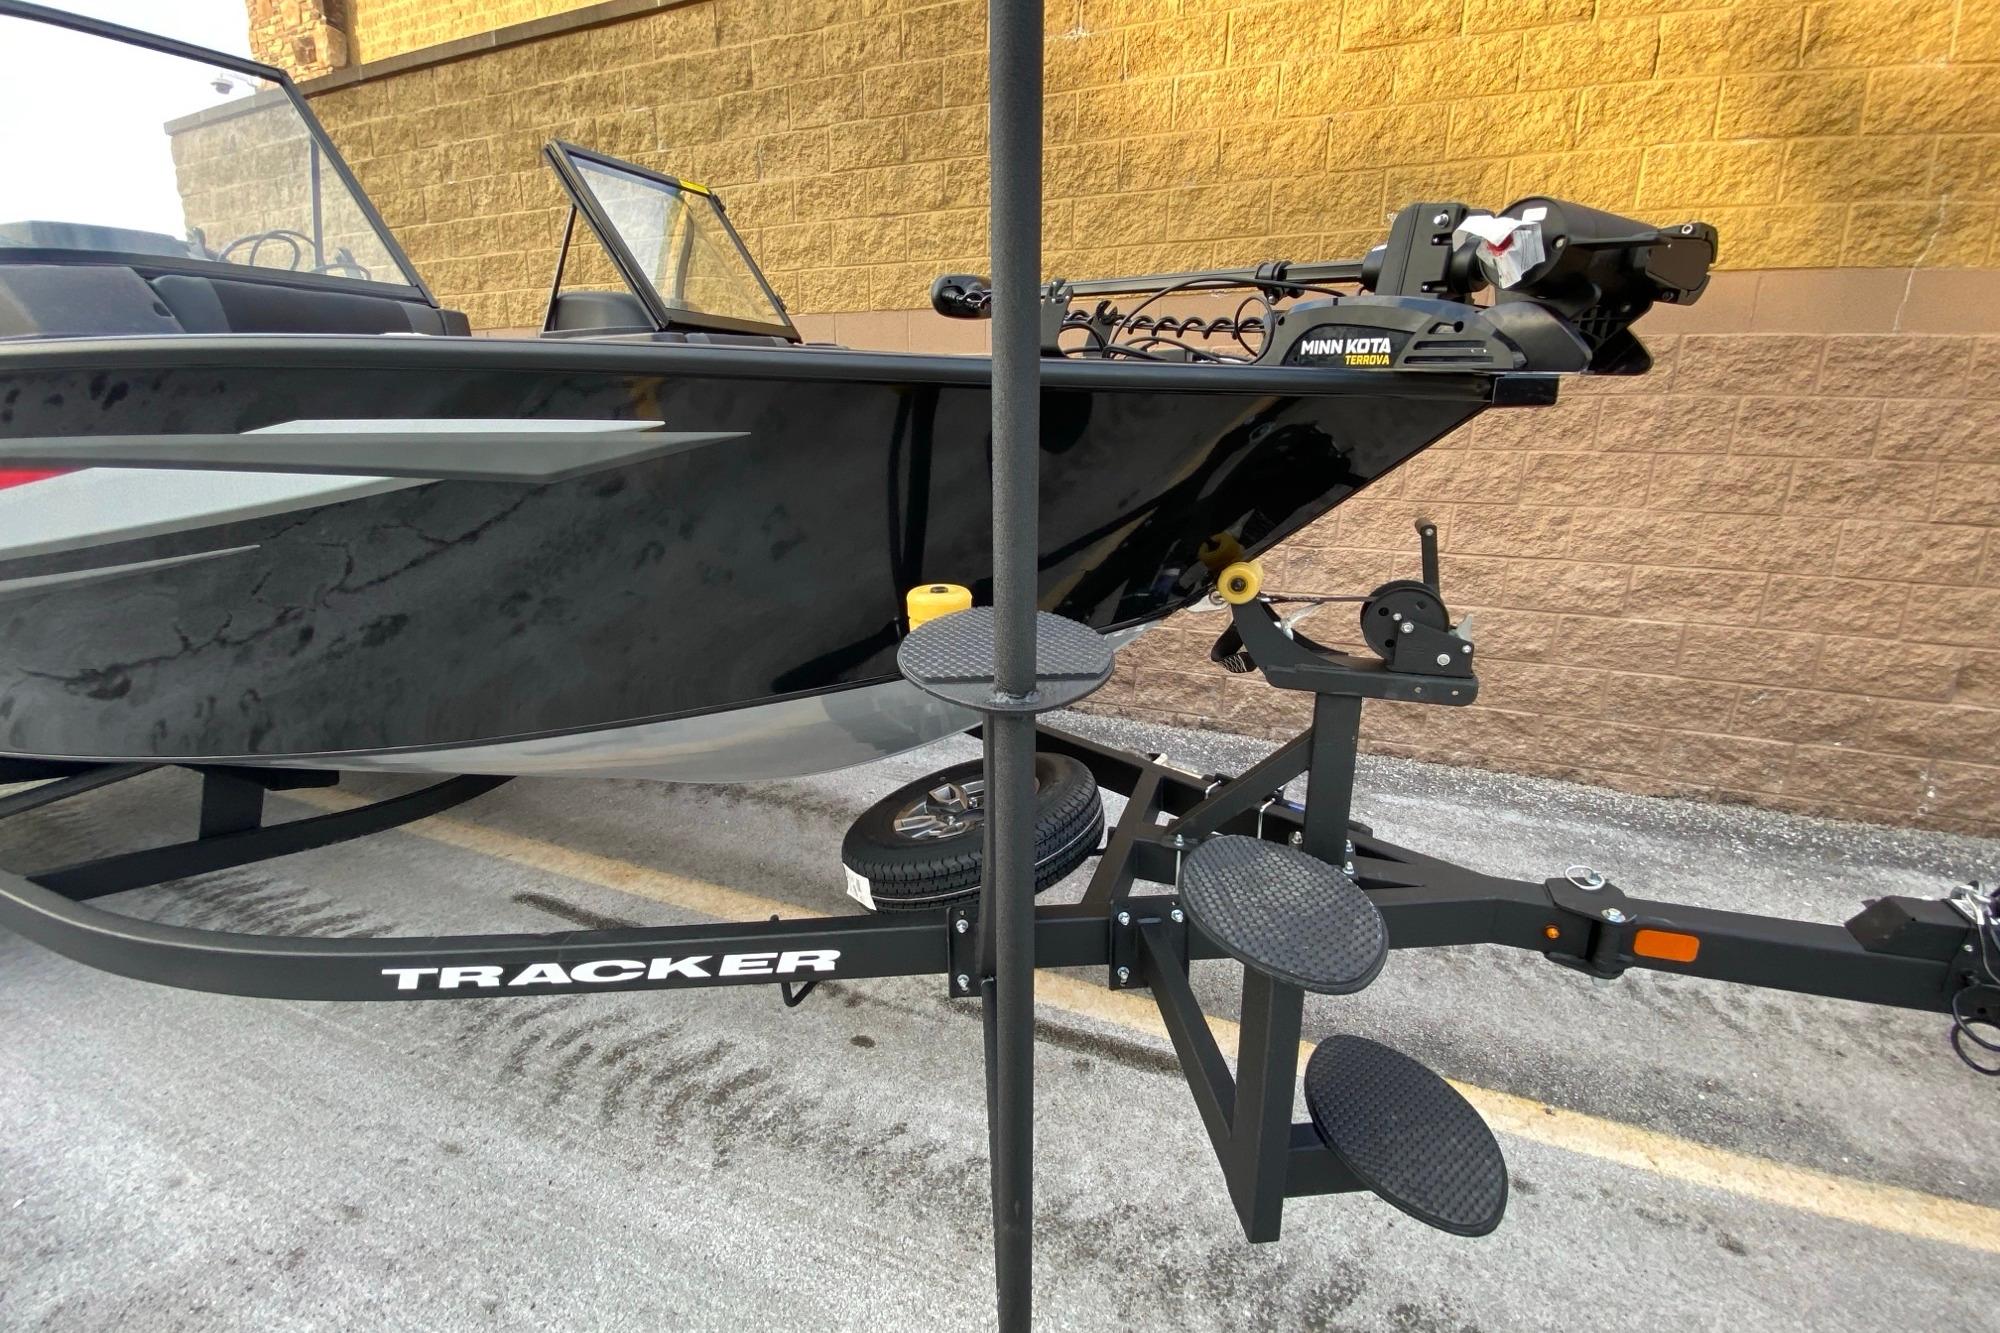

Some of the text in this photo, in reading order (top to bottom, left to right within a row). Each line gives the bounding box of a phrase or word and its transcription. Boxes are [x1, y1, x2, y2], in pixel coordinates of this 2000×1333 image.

[1300, 337, 1391, 355] MINN KOTA
[1345, 354, 1390, 366] TERROVA
[381, 949, 841, 990] TRACKER
